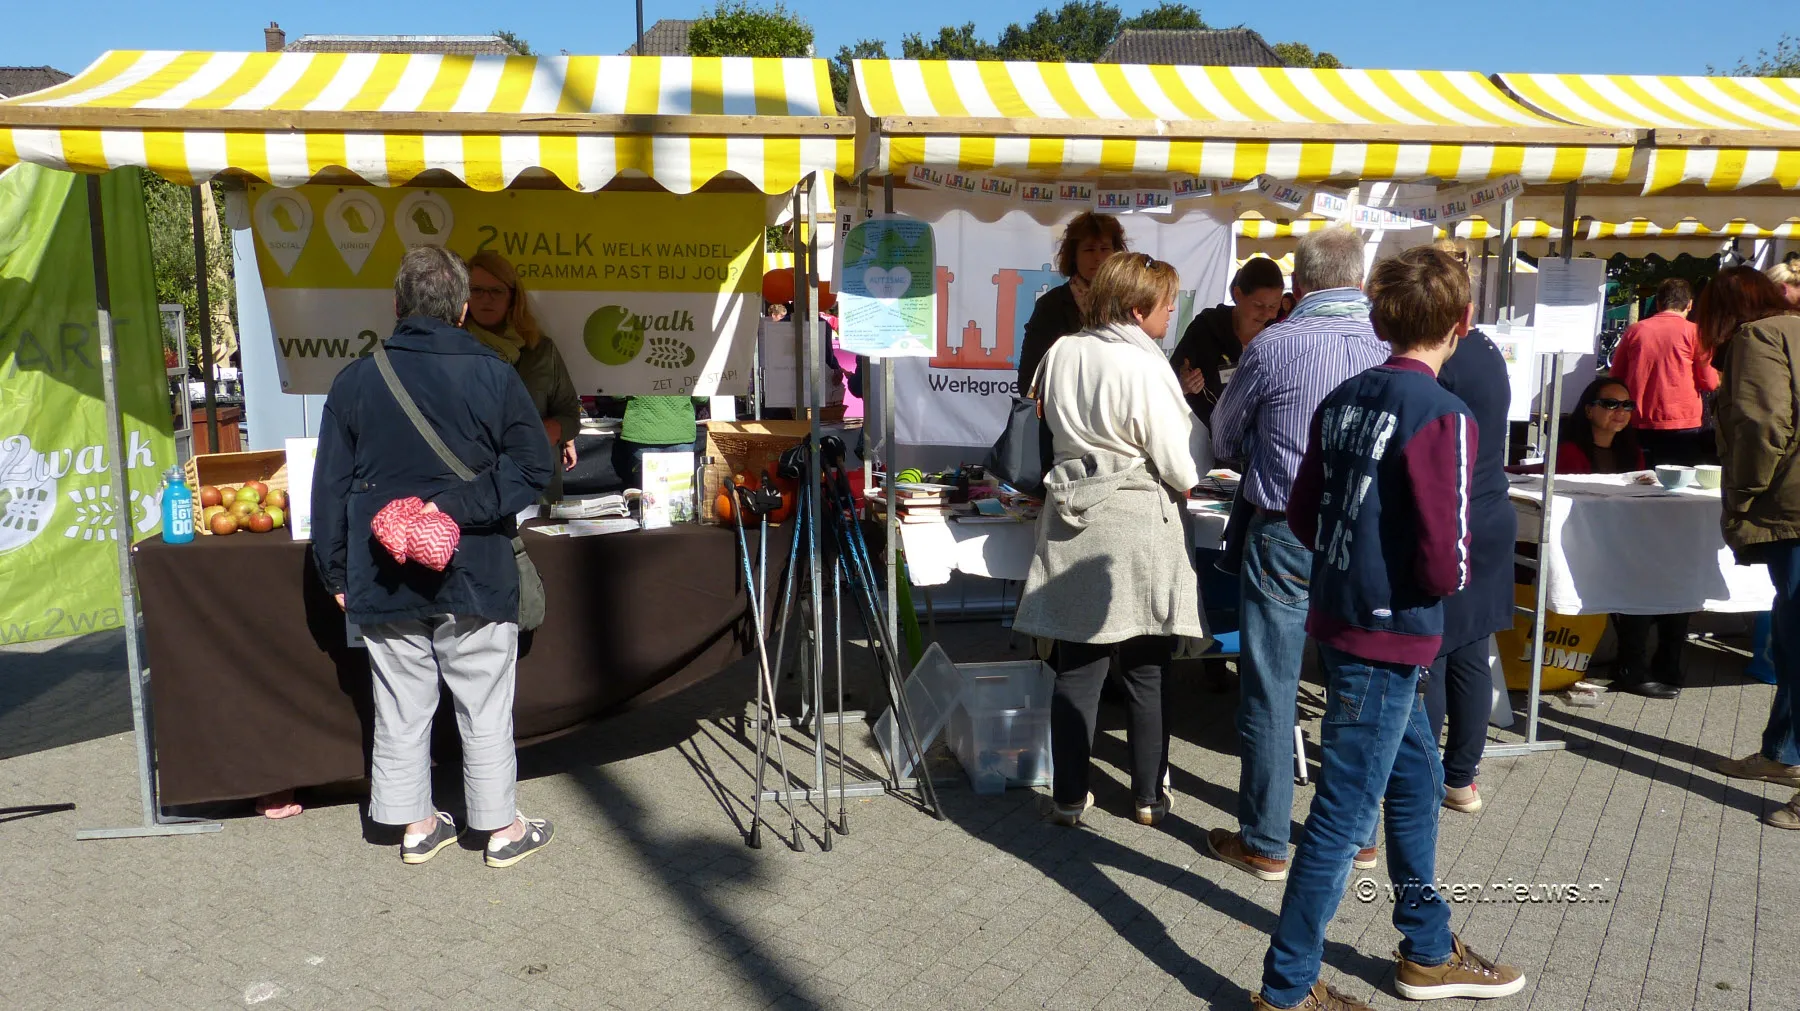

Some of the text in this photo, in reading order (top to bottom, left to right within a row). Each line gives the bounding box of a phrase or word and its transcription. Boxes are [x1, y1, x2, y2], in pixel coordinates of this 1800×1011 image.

[269, 241, 300, 250] SOCIAL
[339, 242, 370, 250] JUNIOR
[477, 225, 741, 259] 2WALK WELK WANDEL-
[515, 263, 739, 281] GRAMMA PAST BIJ JOU?
[617, 305, 695, 332] 2walk
[652, 378, 673, 391] ZET
[707, 369, 738, 384] STAP!
[928, 374, 1019, 396] Werkgroe
[0, 431, 156, 486] 2wak
[1518, 642, 1592, 673] JUMB
